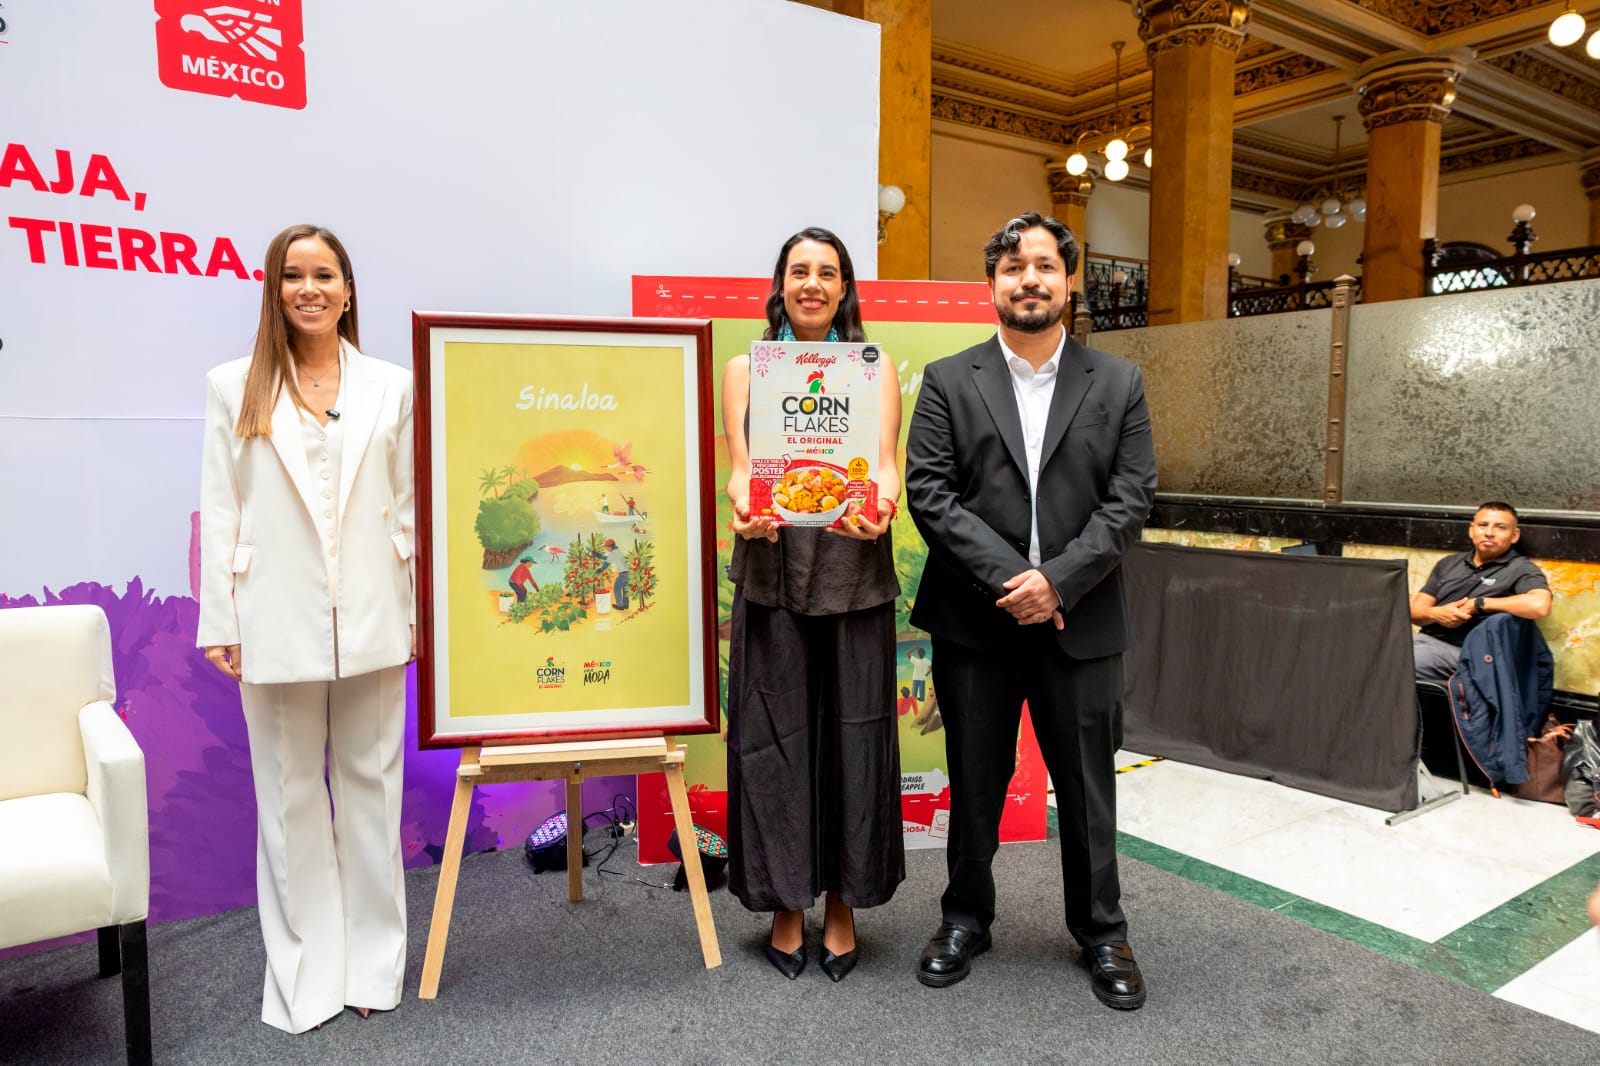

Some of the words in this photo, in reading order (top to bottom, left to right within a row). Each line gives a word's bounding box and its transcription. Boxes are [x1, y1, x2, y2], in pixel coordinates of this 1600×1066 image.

[181, 54, 285, 90] MÉXICO
[8, 216, 264, 282] TIERRA.
[795, 352, 837, 368] Kellogg's
[515, 383, 618, 411] Sinaloa
[782, 396, 850, 416] CORN
[784, 416, 849, 433] FLAKES
[800, 437, 843, 445] ORIGINAL
[806, 446, 834, 454] MÉXICO
[536, 667, 565, 677] CORN
[537, 676, 565, 684] FLAKES
[584, 669, 610, 686] MODA
